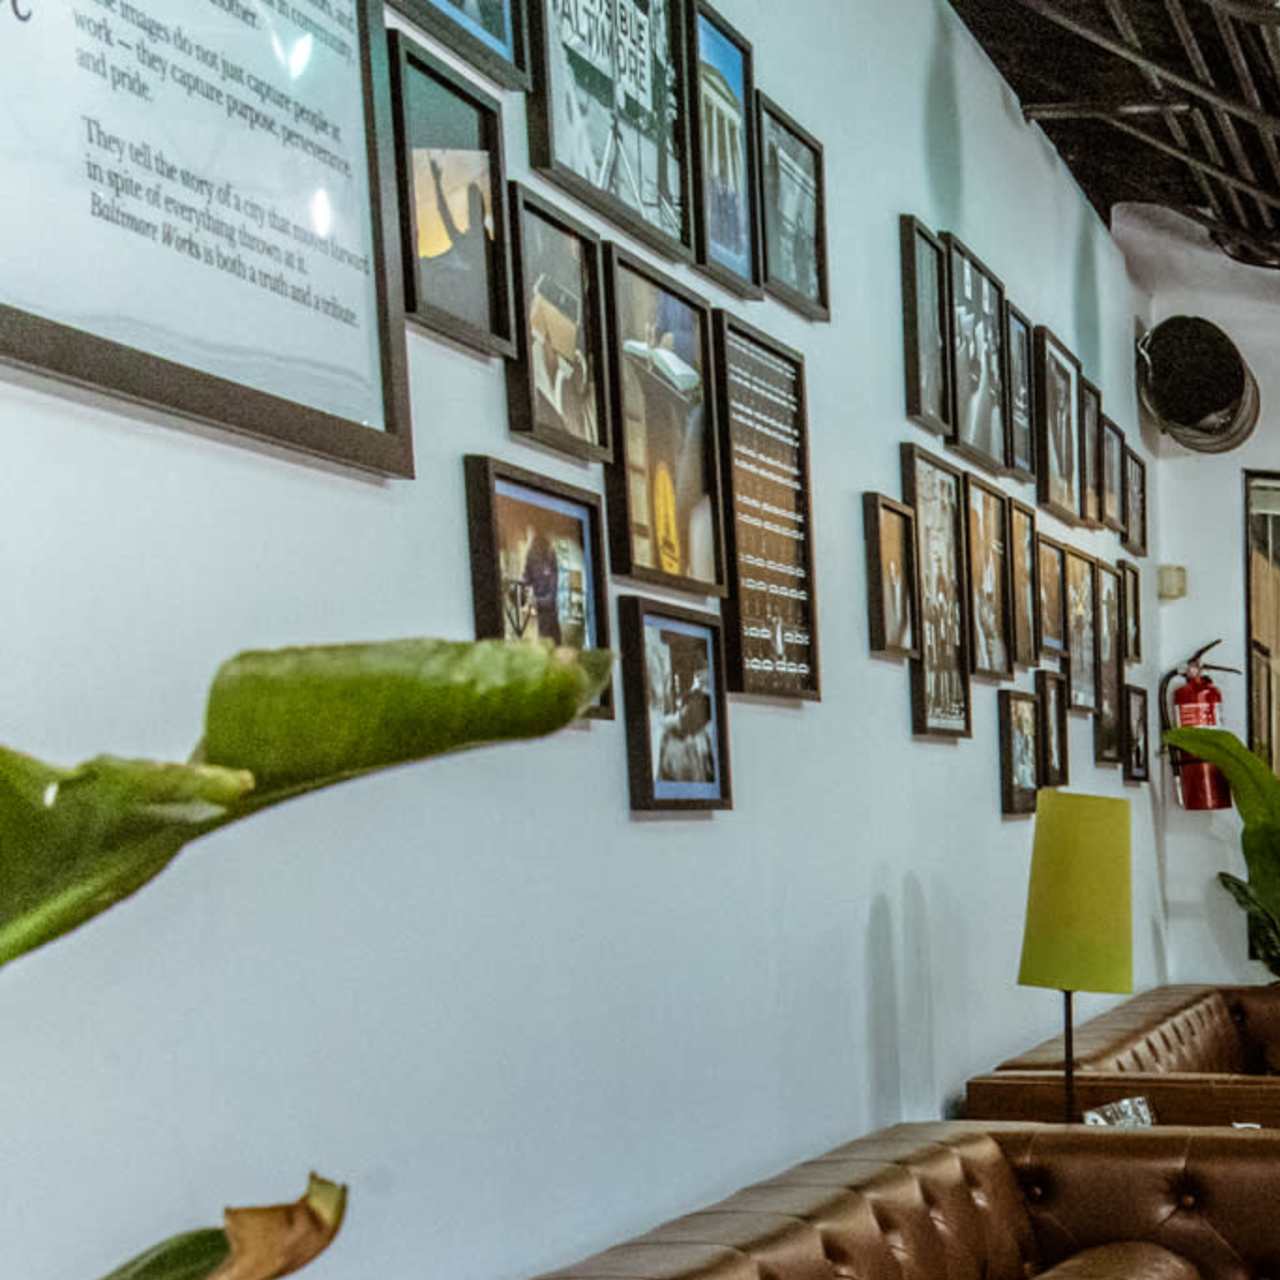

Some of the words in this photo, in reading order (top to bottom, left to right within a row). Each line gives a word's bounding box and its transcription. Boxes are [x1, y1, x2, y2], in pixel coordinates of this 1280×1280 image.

[73, 9, 114, 47] work
[136, 38, 169, 82] they
[170, 63, 223, 106] capture
[76, 48, 108, 80] and
[110, 65, 154, 102] pride.
[119, 2, 172, 43] images
[173, 26, 193, 56] do
[195, 44, 219, 71] not
[246, 73, 291, 113] capture
[81, 114, 126, 163] They
[128, 141, 153, 171] tell
[154, 149, 178, 183] the
[180, 167, 214, 205] story
[216, 180, 232, 208] of
[234, 193, 241, 212] a
[85, 152, 104, 184] in
[107, 167, 143, 201] spite
[145, 182, 161, 210] of
[164, 194, 237, 249] everything
[91, 190, 159, 242] Baltimore
[161, 221, 202, 261] Works
[203, 244, 215, 266] is
[216, 243, 247, 280] both
[248, 264, 256, 284] a
